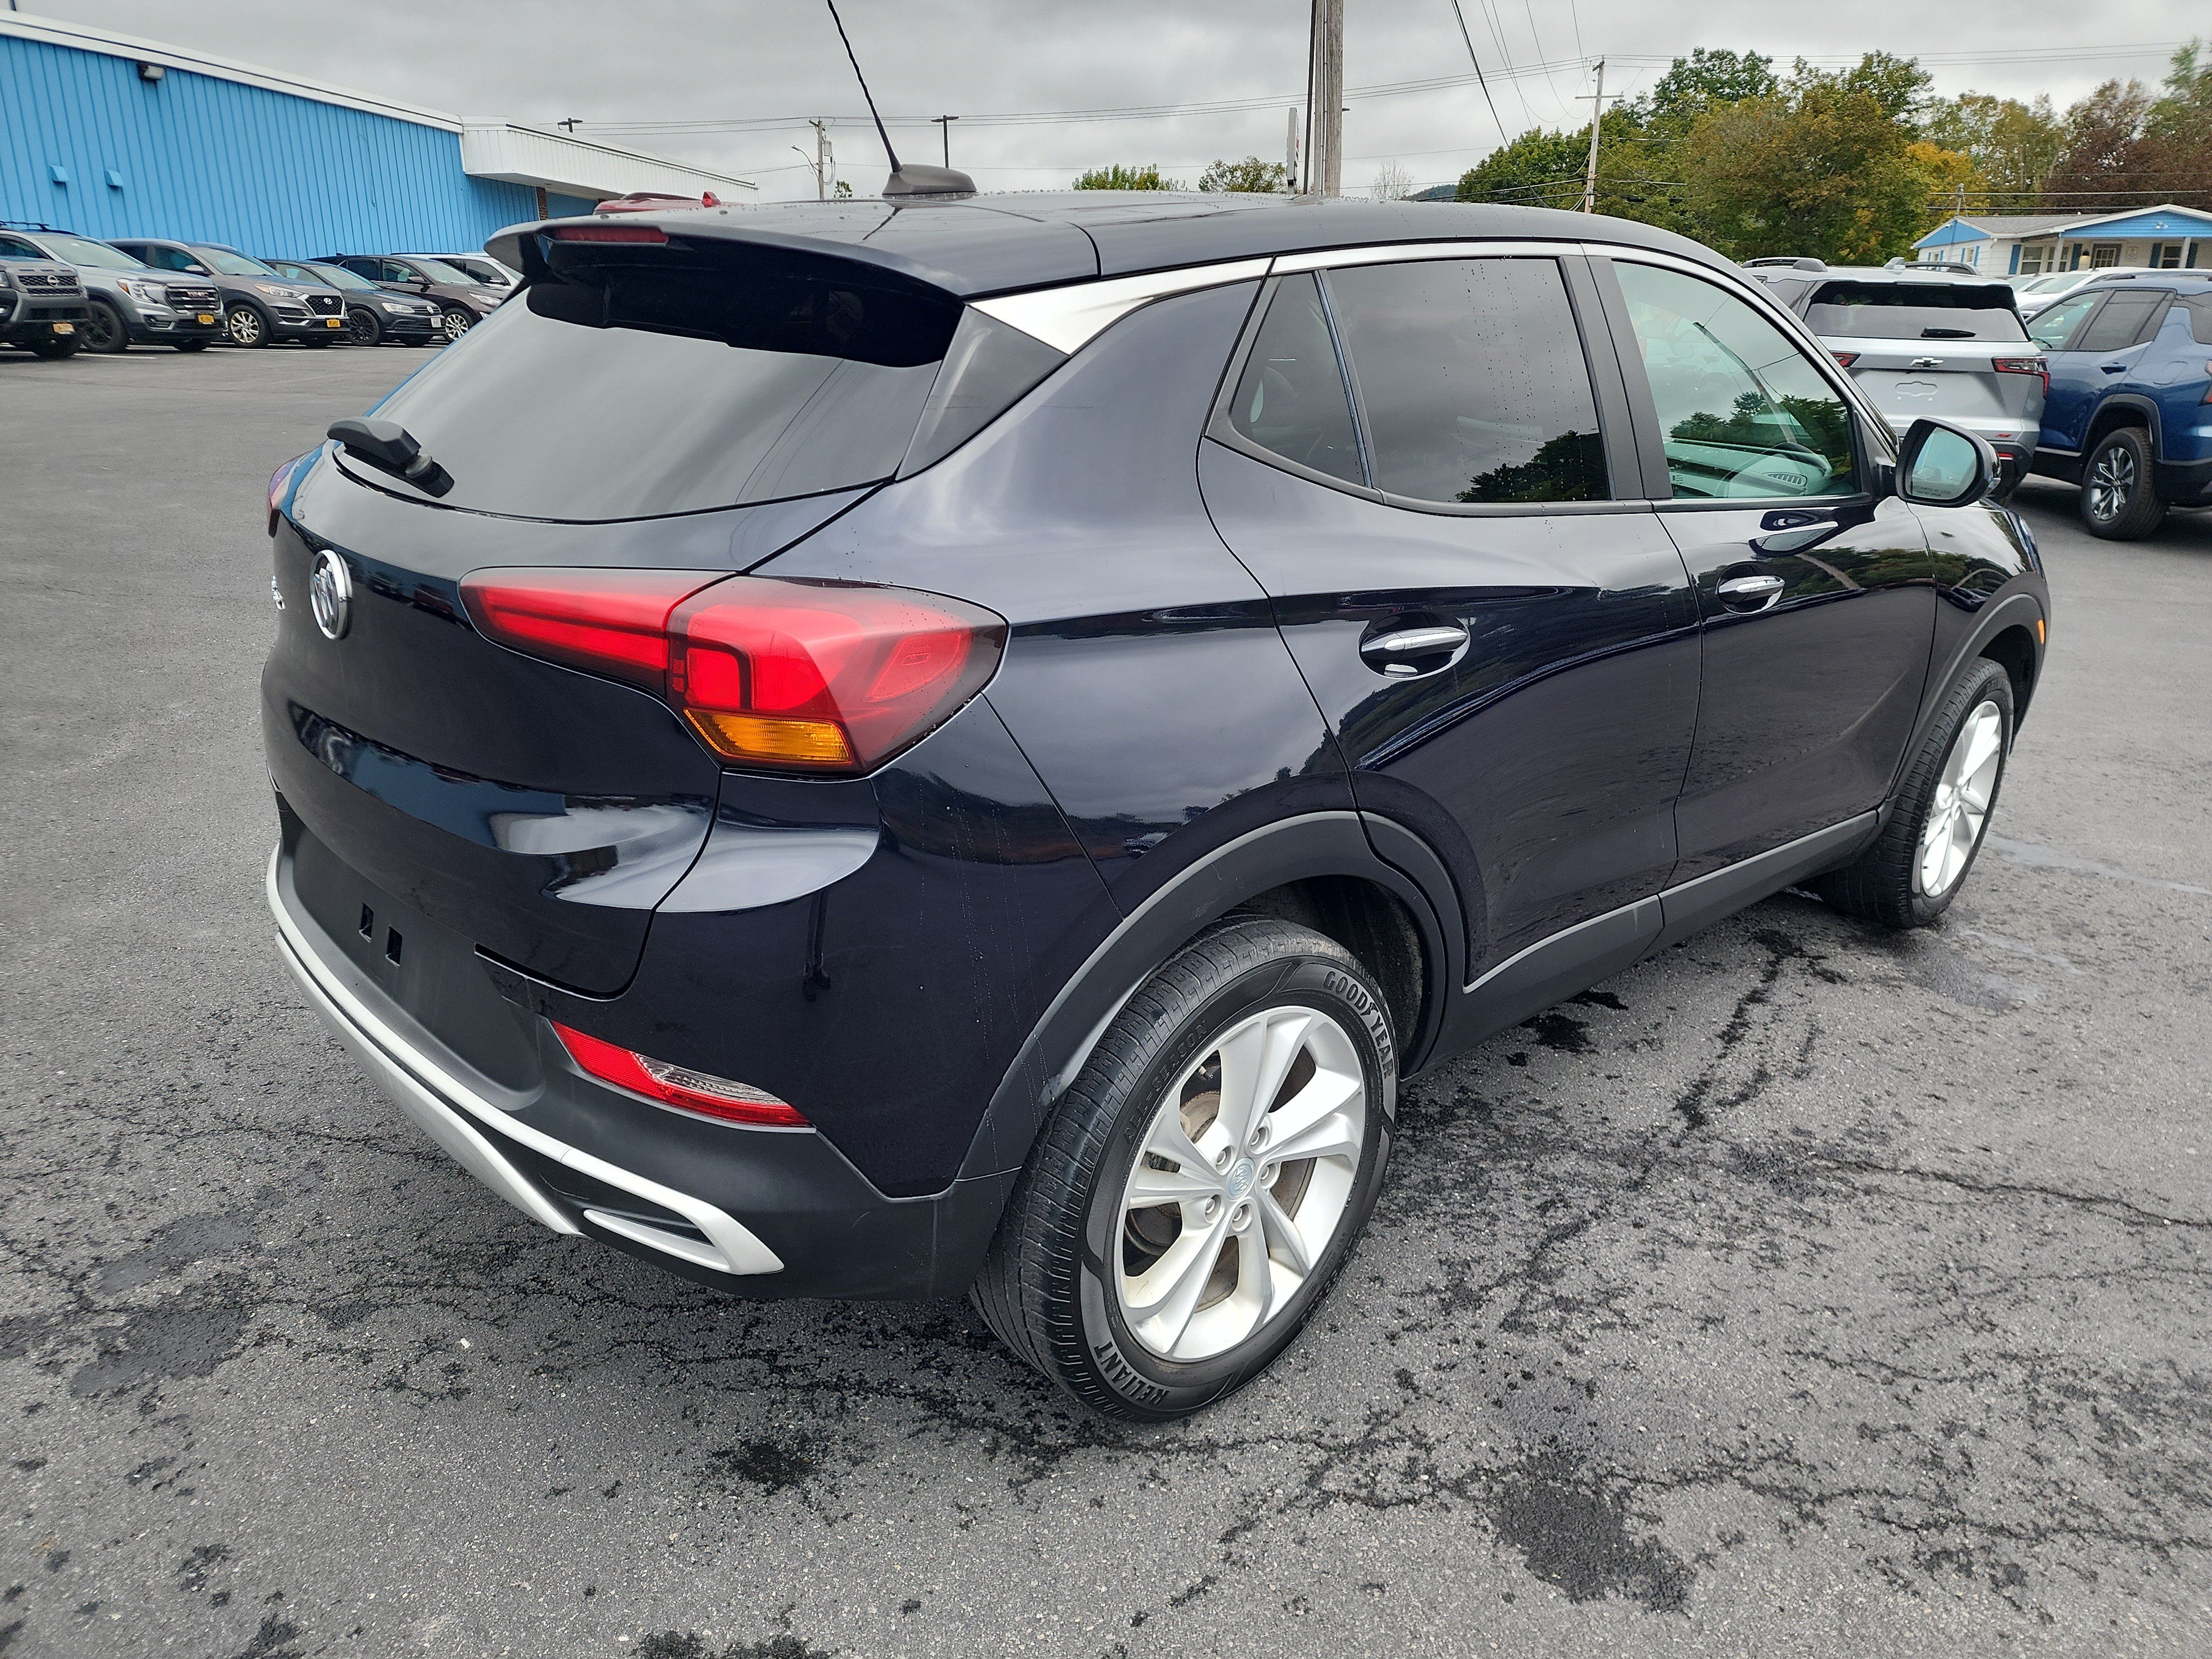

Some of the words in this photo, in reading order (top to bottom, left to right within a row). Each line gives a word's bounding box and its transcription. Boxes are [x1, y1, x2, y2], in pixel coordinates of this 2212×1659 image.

[1323, 970, 1395, 1079] GOODYEAR
[1124, 1020, 1208, 1144] ALL-SEASON
[1093, 1340, 1171, 1406] RELIANT
